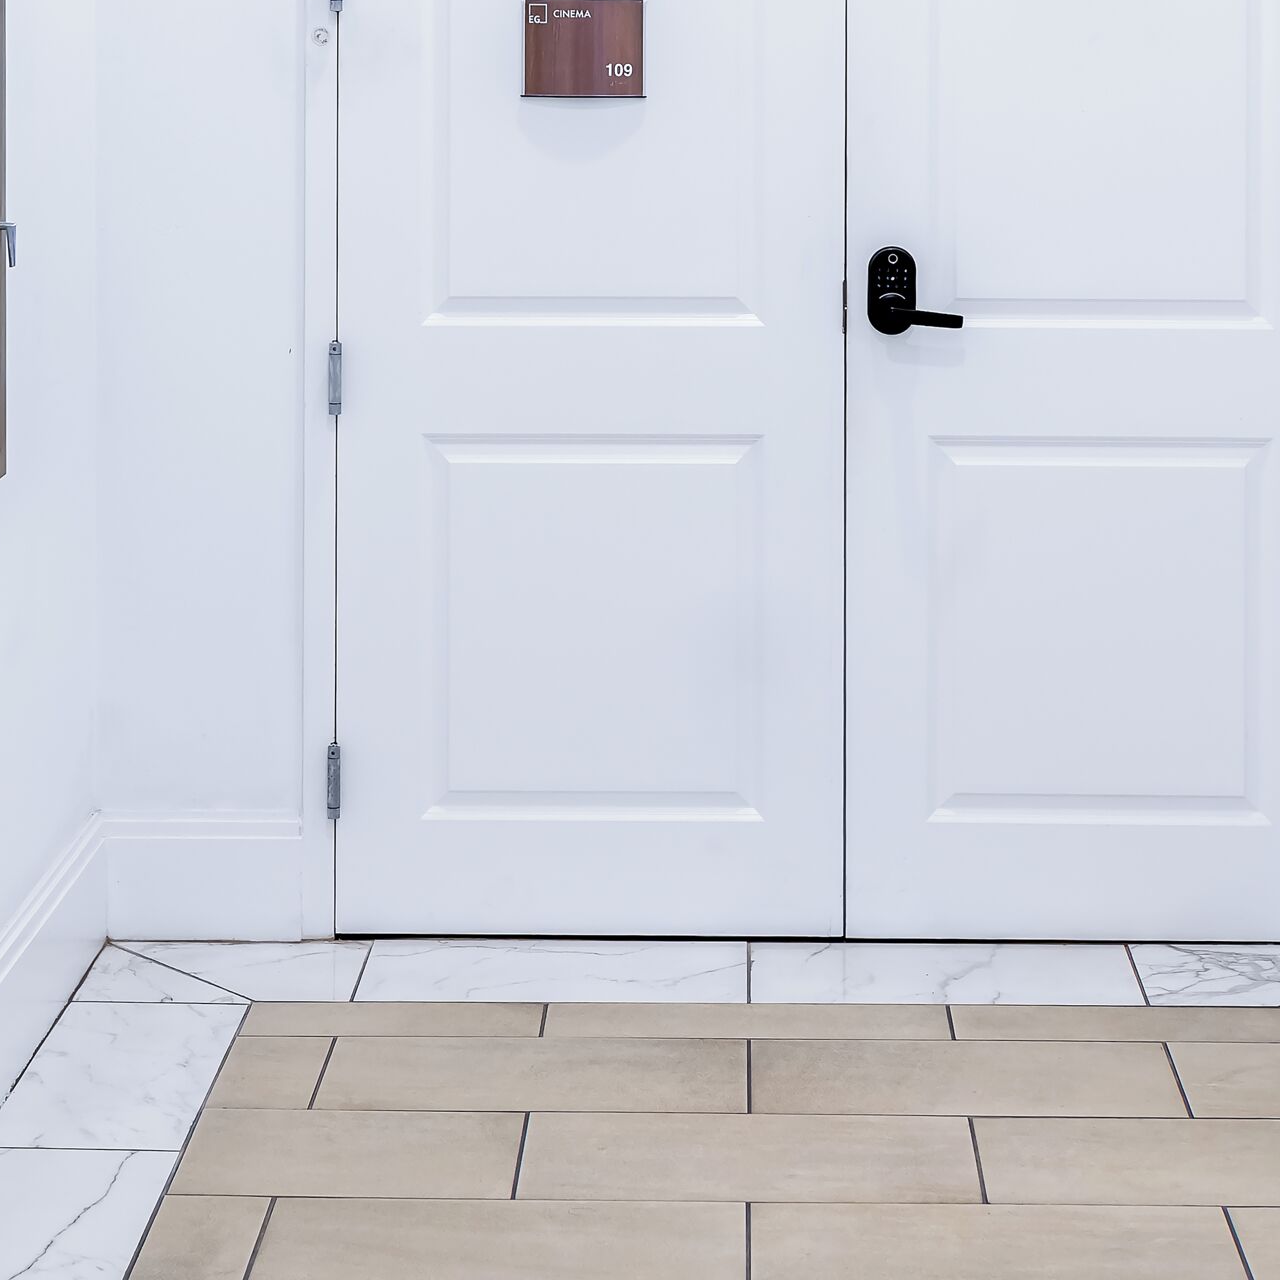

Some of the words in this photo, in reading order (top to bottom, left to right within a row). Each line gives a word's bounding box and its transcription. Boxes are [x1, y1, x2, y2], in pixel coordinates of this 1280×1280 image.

[553, 9, 592, 18] CINEMA
[528, 15, 541, 24] EG
[605, 63, 633, 77] 109
